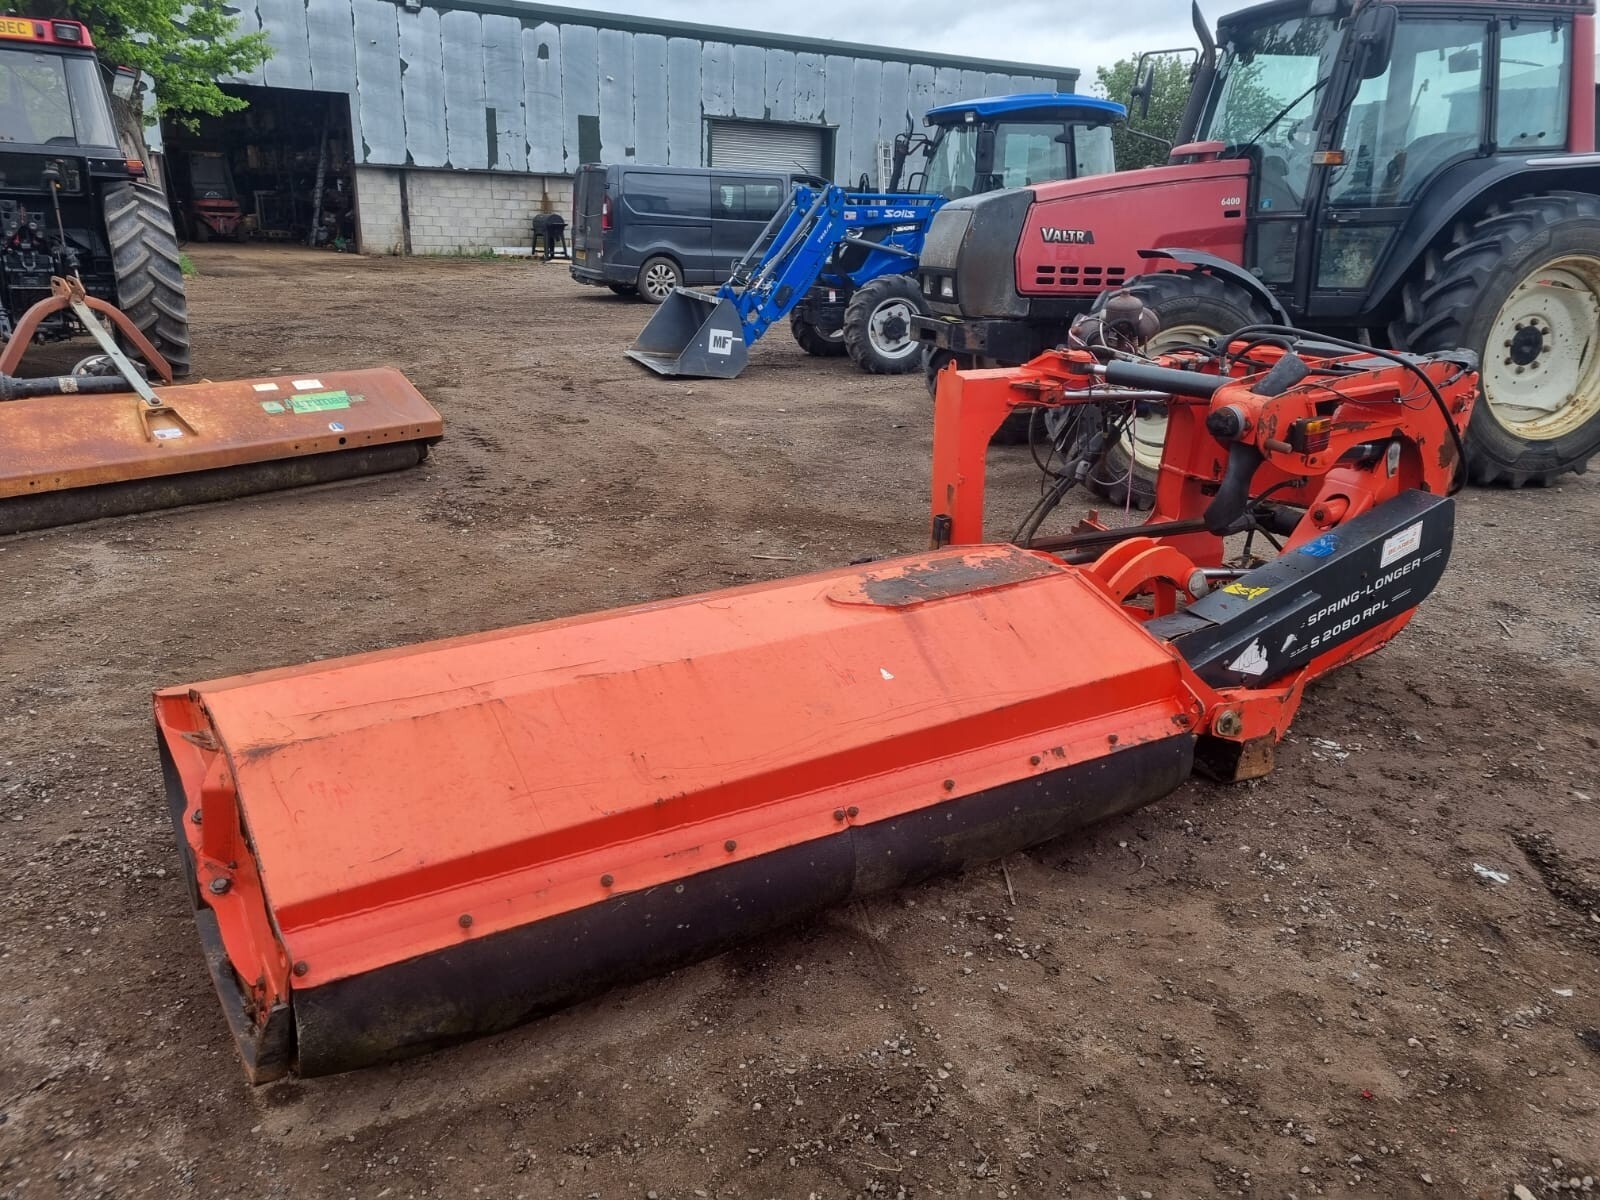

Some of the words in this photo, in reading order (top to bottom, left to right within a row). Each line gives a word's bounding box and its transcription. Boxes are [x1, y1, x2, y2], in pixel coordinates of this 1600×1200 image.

[1221, 197, 1240, 205] 6400
[713, 336, 732, 349] MF
[1307, 558, 1420, 626] SPRING-LONGER
[1310, 635, 1320, 648] S
[1322, 614, 1360, 642] 2080
[1363, 600, 1389, 620] RPL
